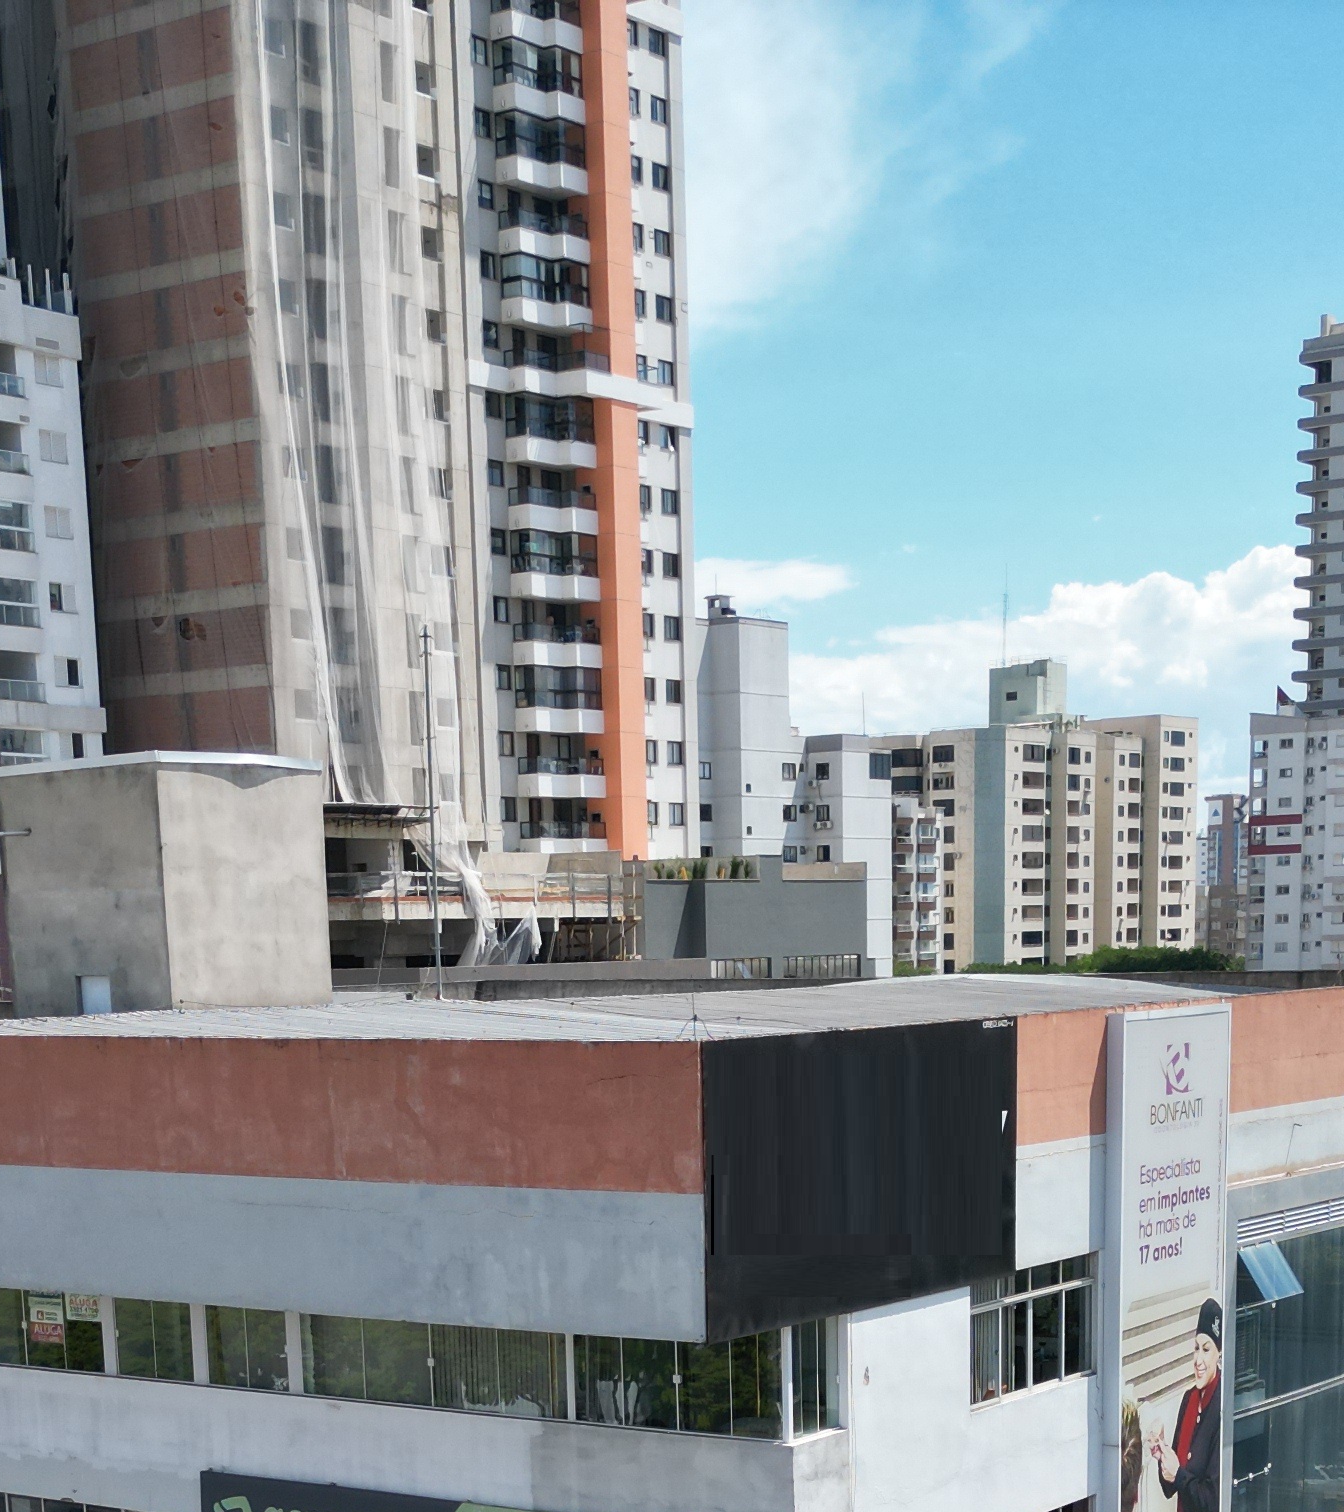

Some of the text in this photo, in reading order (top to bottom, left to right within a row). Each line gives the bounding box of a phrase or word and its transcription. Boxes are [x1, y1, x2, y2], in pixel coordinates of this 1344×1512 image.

[1149, 1098, 1203, 1126] BONFANTI
[1139, 1158, 1201, 1187] Especialista
[1139, 1185, 1211, 1214] em implantes
[1138, 1210, 1197, 1240] há mais de
[1139, 1236, 1183, 1265] 17 anos!
